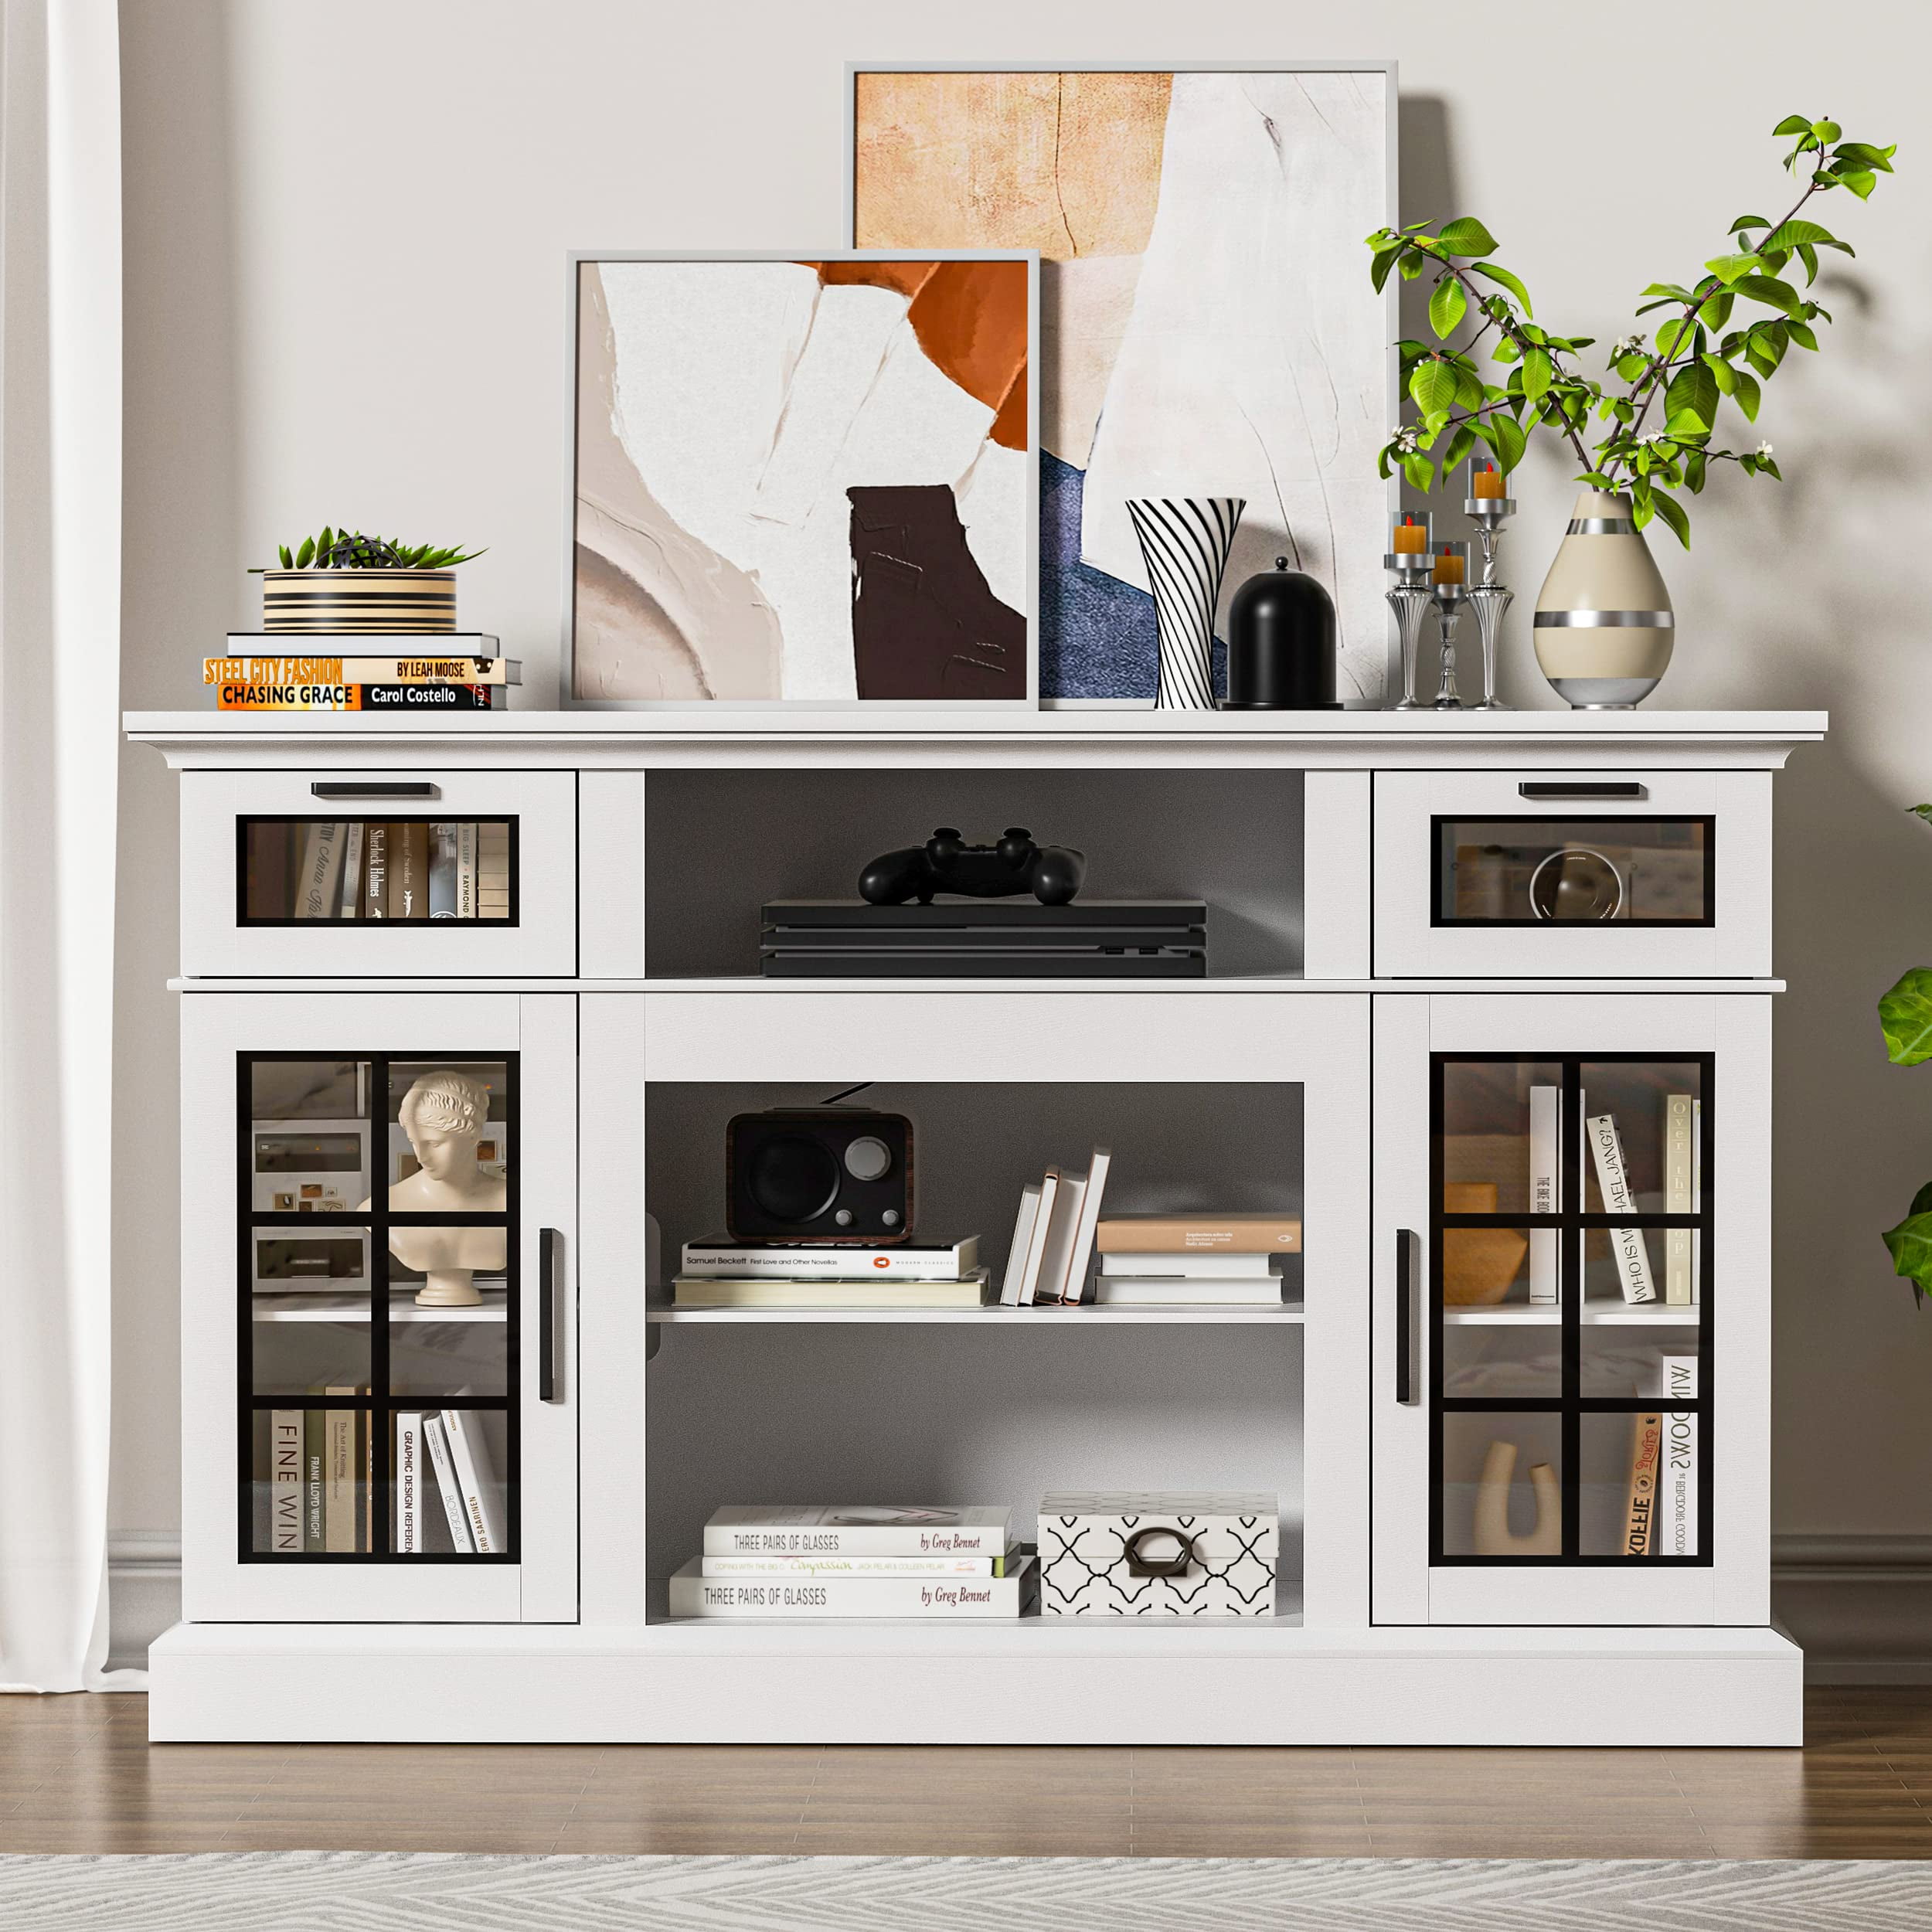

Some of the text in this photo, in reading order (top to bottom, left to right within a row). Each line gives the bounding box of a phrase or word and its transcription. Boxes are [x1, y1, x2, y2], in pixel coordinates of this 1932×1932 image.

[204, 658, 343, 684] STEEL CITY FASHION
[396, 662, 464, 677] BY LEAH MOOSE
[223, 685, 352, 704] CHASING GRACE
[371, 687, 456, 703] Carol Costello
[313, 846, 330, 884] Anna
[370, 829, 384, 897] Sherlock Holmes
[403, 857, 413, 884] Sweden
[1537, 1177, 1550, 1186] THE
[1673, 1102, 1686, 1254] Over the op
[1600, 1128, 1648, 1301] WHO IS MHAEL JANG?
[404, 1430, 413, 1472] GRAPHIC
[338, 1454, 347, 1478] Knitting
[277, 1425, 298, 1549] FINE WIN
[311, 1456, 320, 1539] FRANK LLOYD WRIGHT
[404, 1475, 413, 1509] DESIGN
[445, 1495, 465, 1545] BORDEAUX
[469, 1496, 485, 1534] SAARINEN
[734, 1534, 839, 1550] THREE PAIRS OF GLASSES
[920, 1533, 980, 1551] by Greg Bennet
[705, 1587, 827, 1606] THREE PAIRS OF GLASSES
[921, 1587, 991, 1607] by Greg Bennet
